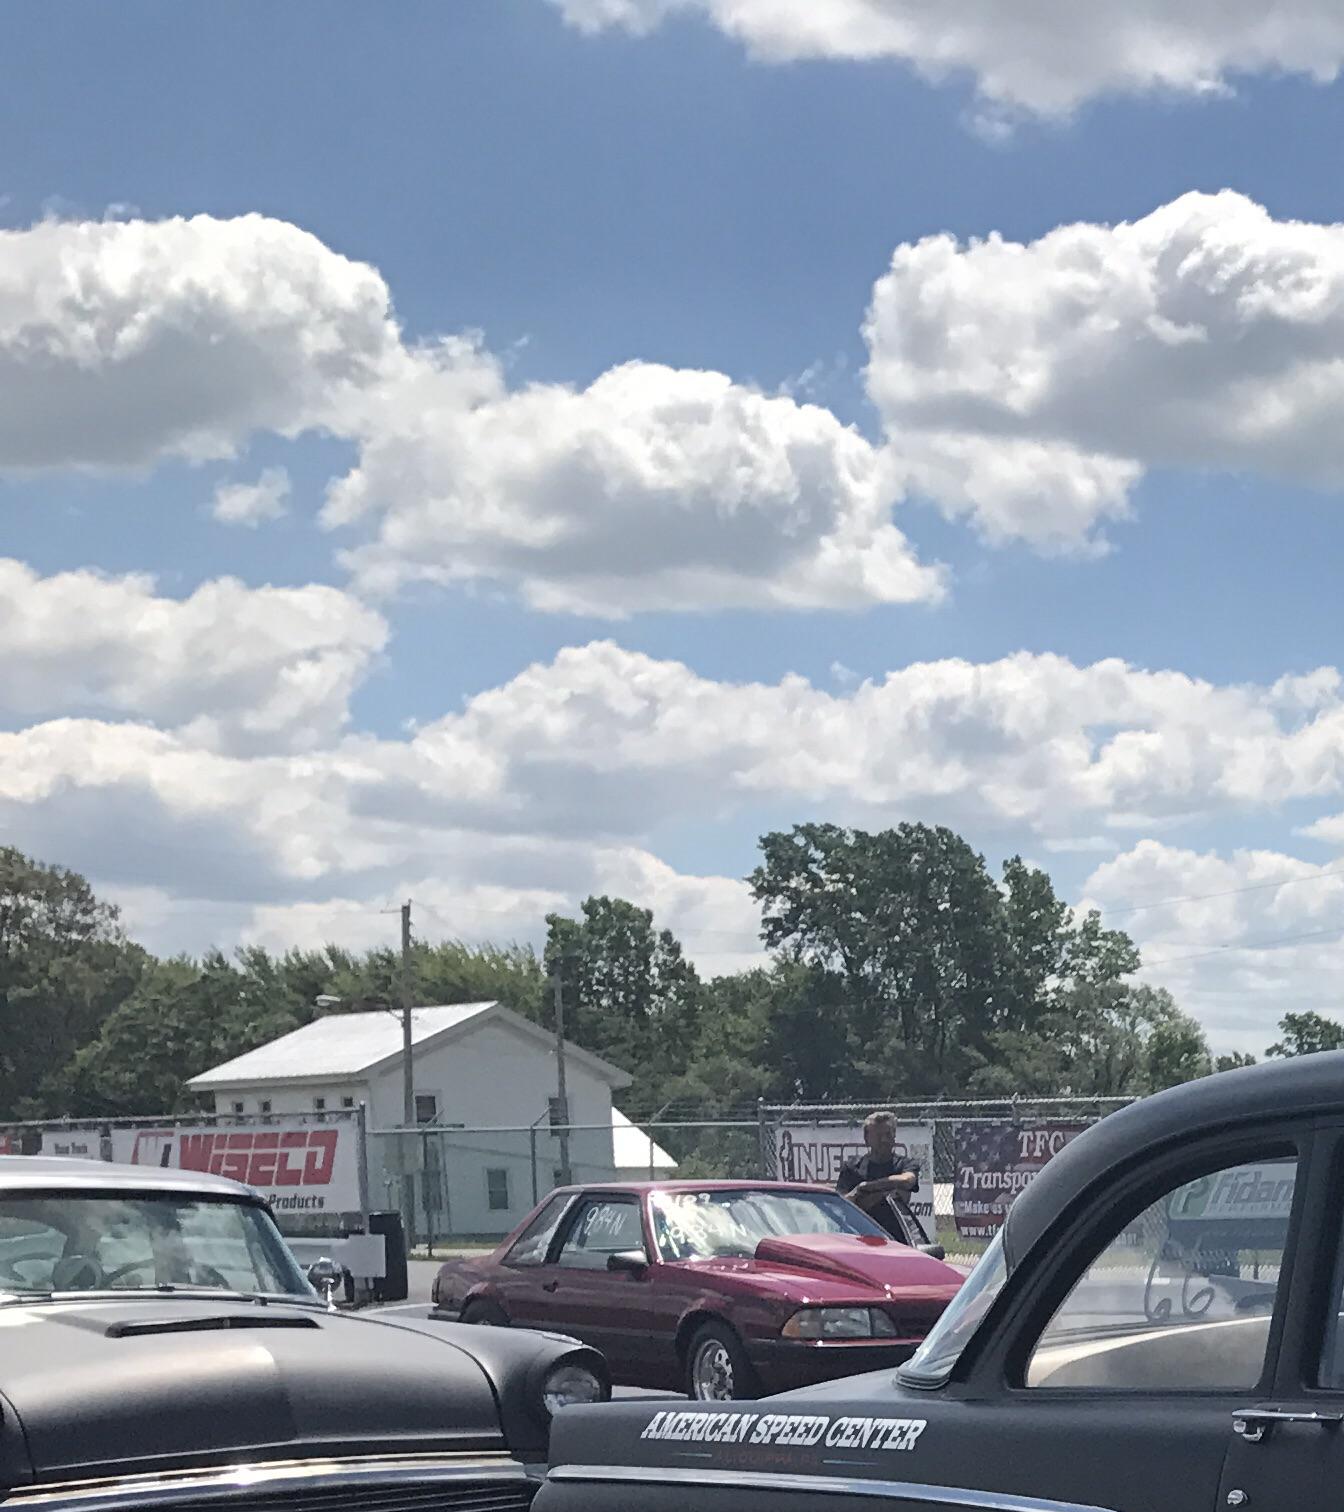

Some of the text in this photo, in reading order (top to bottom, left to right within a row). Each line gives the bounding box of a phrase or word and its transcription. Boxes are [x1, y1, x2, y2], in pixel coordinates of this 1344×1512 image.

[268, 1193, 324, 1210] Products
[640, 1411, 928, 1451] AMERICAN SPEED CENTER
